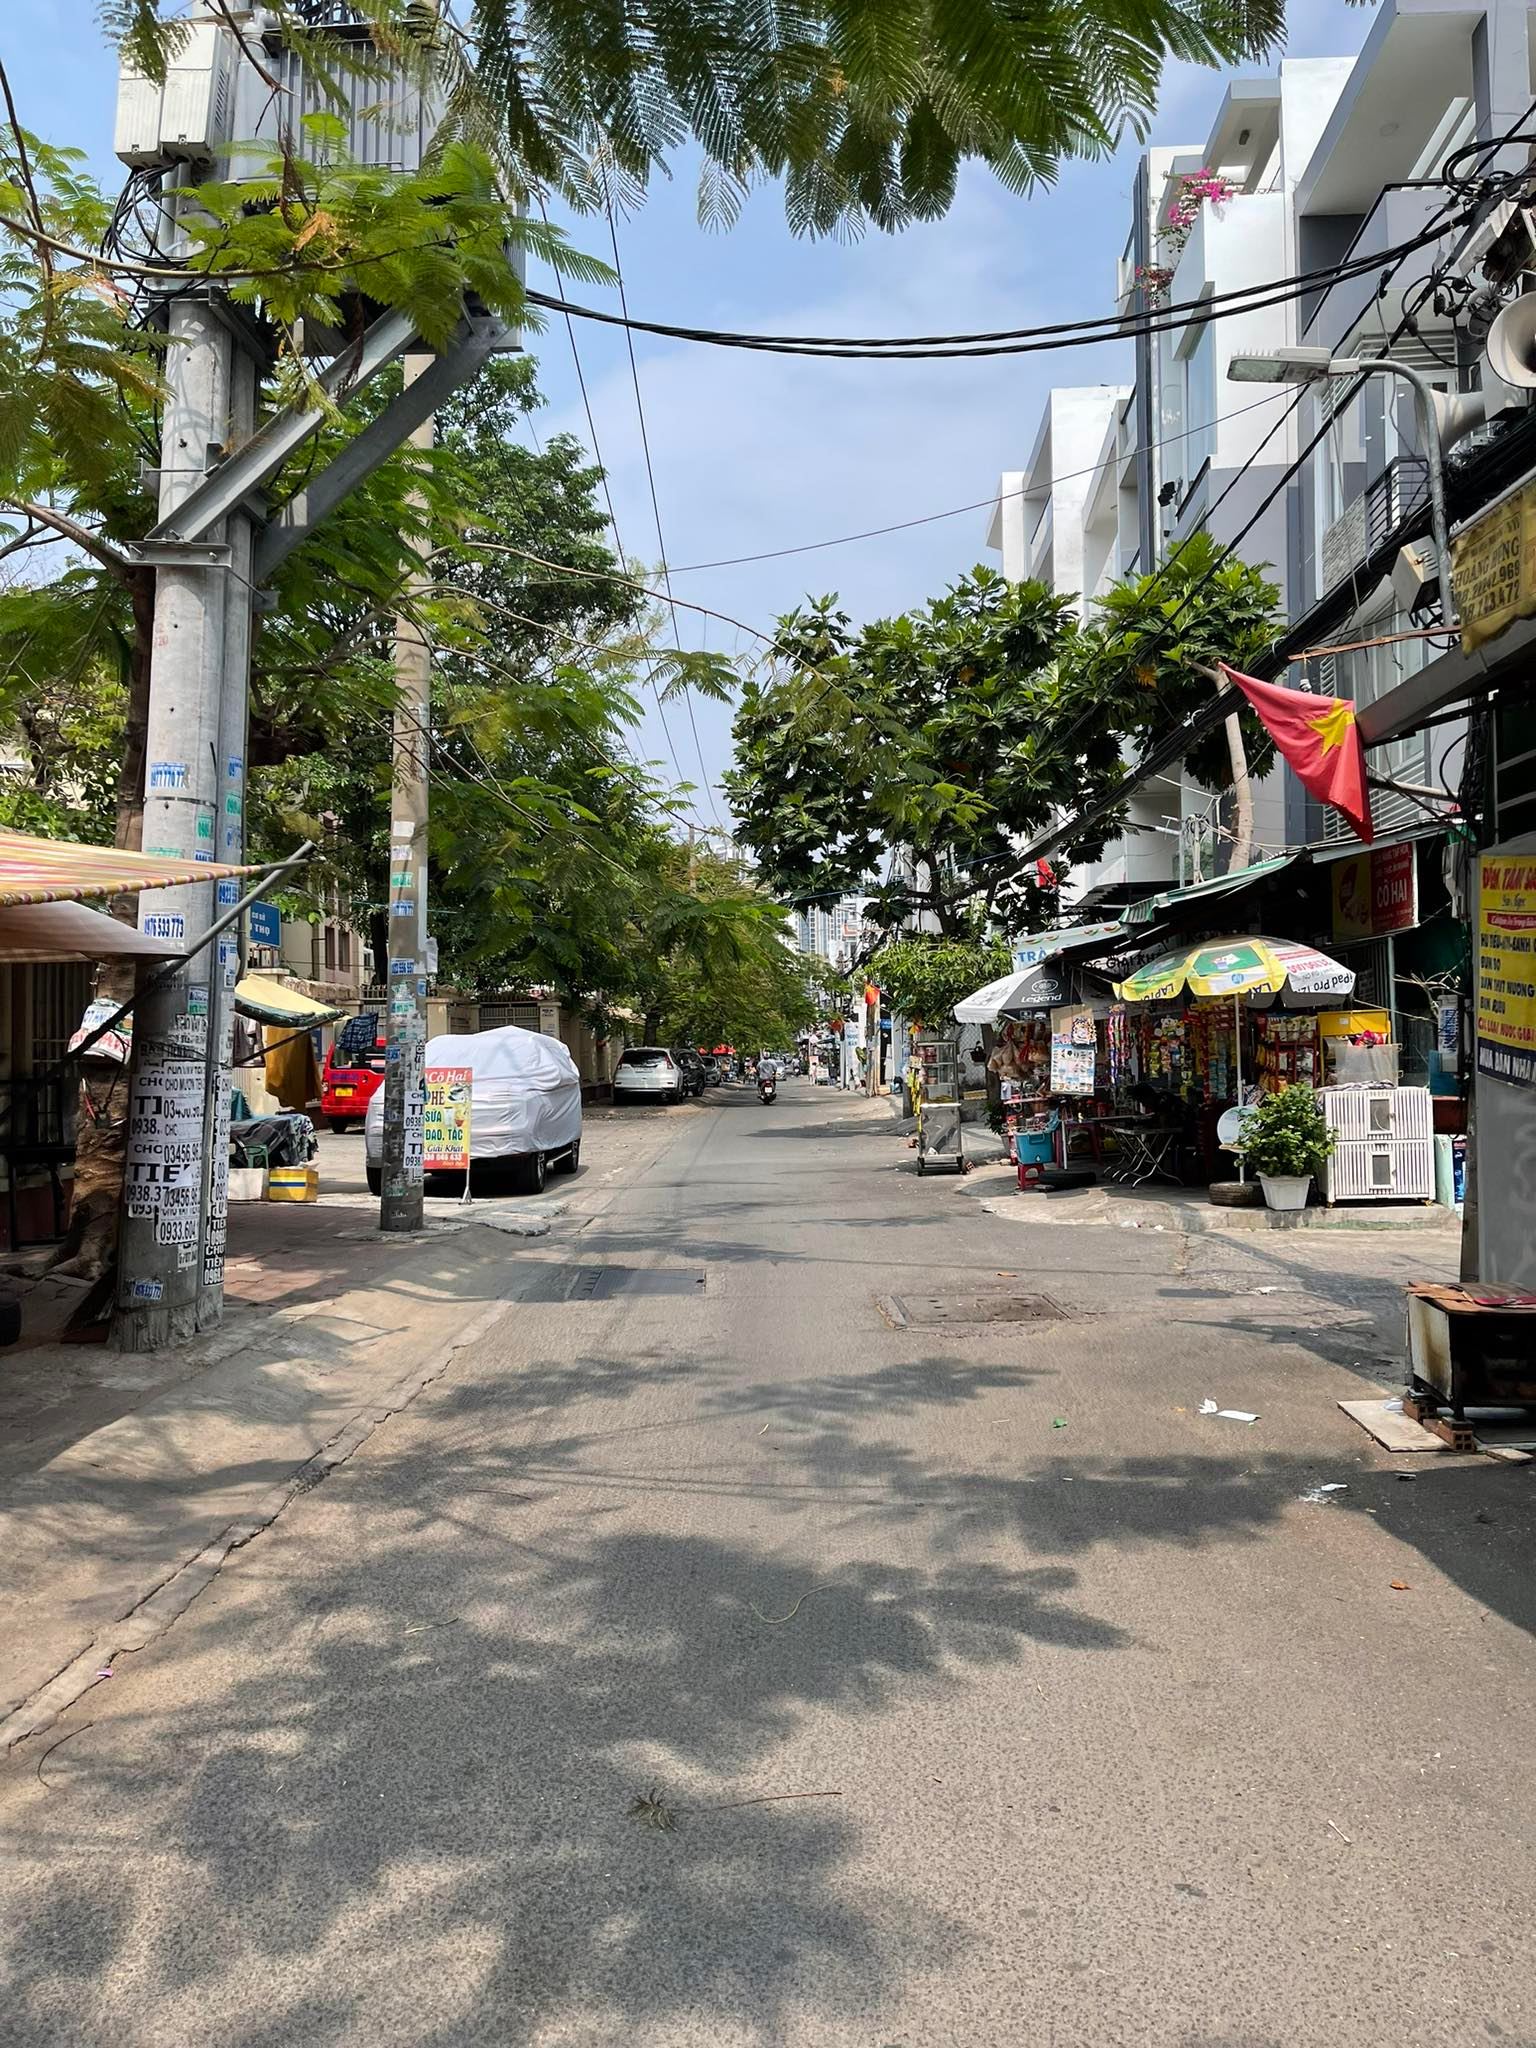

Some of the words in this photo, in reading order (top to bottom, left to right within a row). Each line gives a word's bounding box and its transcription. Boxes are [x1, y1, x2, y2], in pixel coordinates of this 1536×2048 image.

[1377, 879, 1390, 908] CÔ
[1391, 878, 1408, 904] HAI
[255, 924, 270, 936] THỌ
[1021, 992, 1062, 1004] Legend
[428, 1071, 444, 1083] Cô
